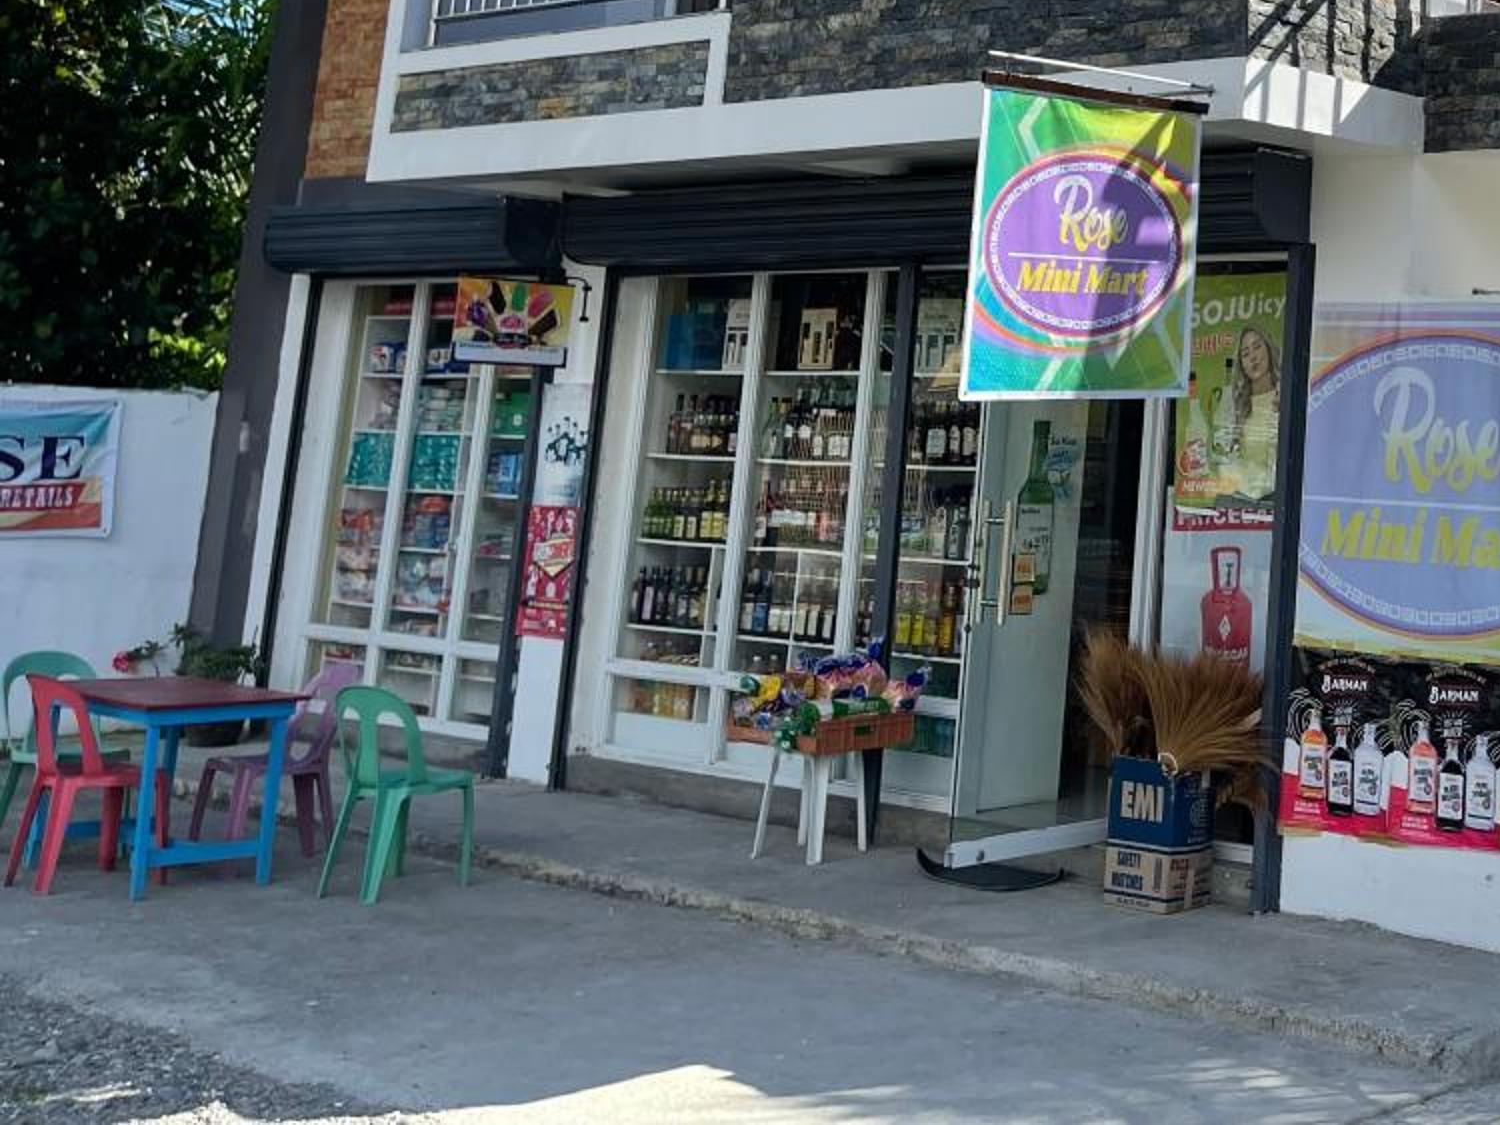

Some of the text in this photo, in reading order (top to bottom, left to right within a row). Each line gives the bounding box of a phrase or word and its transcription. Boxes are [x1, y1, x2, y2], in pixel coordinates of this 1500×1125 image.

[1054, 175, 1129, 252] Rose
[1017, 260, 1149, 297] Mini Mart
[1321, 506, 1428, 564] Mini
[1322, 675, 1368, 693] BARMAN
[1429, 686, 1479, 704] BARMAN
[1120, 780, 1165, 823] EMI
